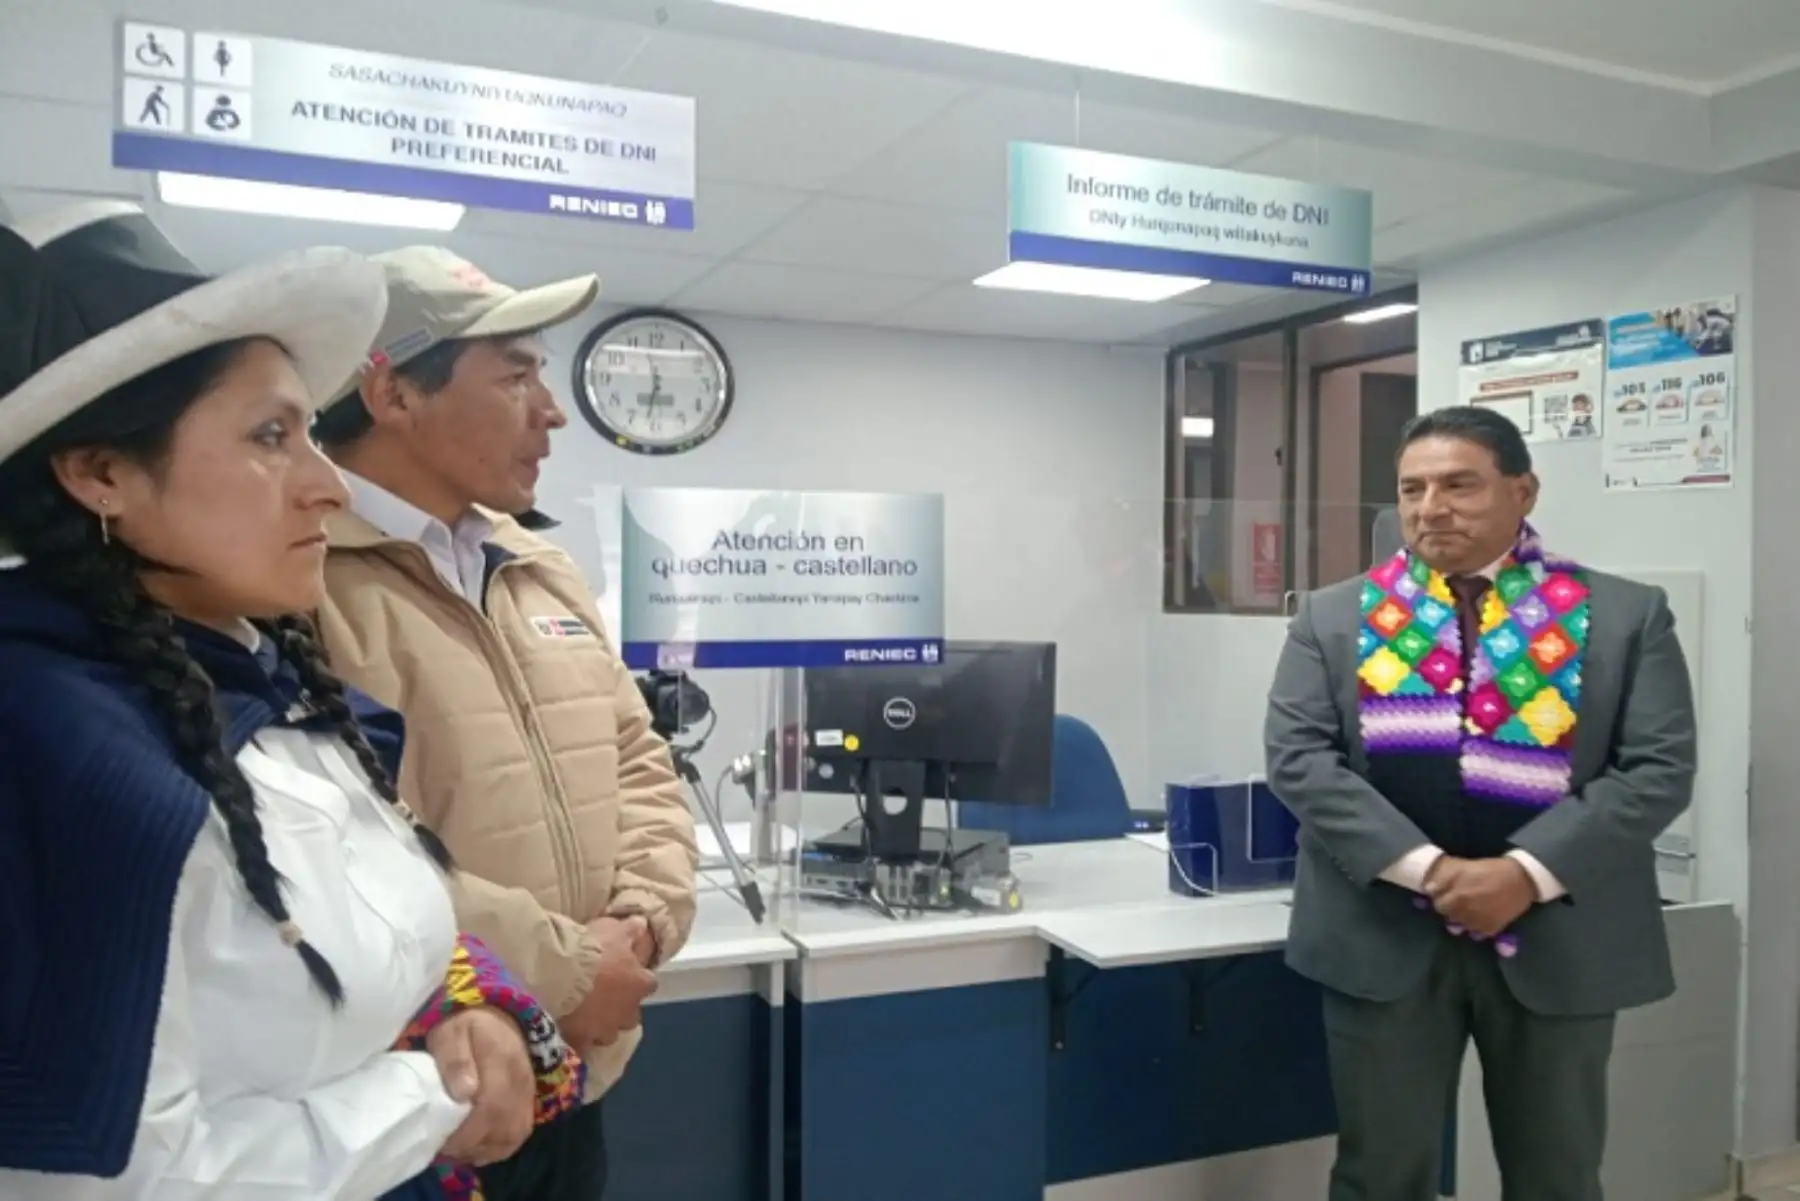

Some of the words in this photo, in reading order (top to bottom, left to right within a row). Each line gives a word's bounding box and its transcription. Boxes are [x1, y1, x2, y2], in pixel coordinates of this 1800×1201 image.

[291, 99, 417, 133] ATENCIÓN
[423, 117, 456, 136] DE
[463, 121, 579, 152] TRAMITES
[583, 137, 616, 158] DE
[619, 141, 657, 162] DNI
[390, 137, 570, 174] PREFERENCIAL
[1067, 172, 1150, 205] Informe
[1156, 183, 1183, 208] de
[1189, 189, 1258, 218] trámite
[1263, 199, 1289, 221] de
[1292, 202, 1329, 226] DNI
[711, 530, 826, 552] Atención
[834, 535, 864, 552] en
[651, 554, 767, 580] quechua
[793, 555, 918, 577] castellano
[844, 647, 918, 663] RENIEC
